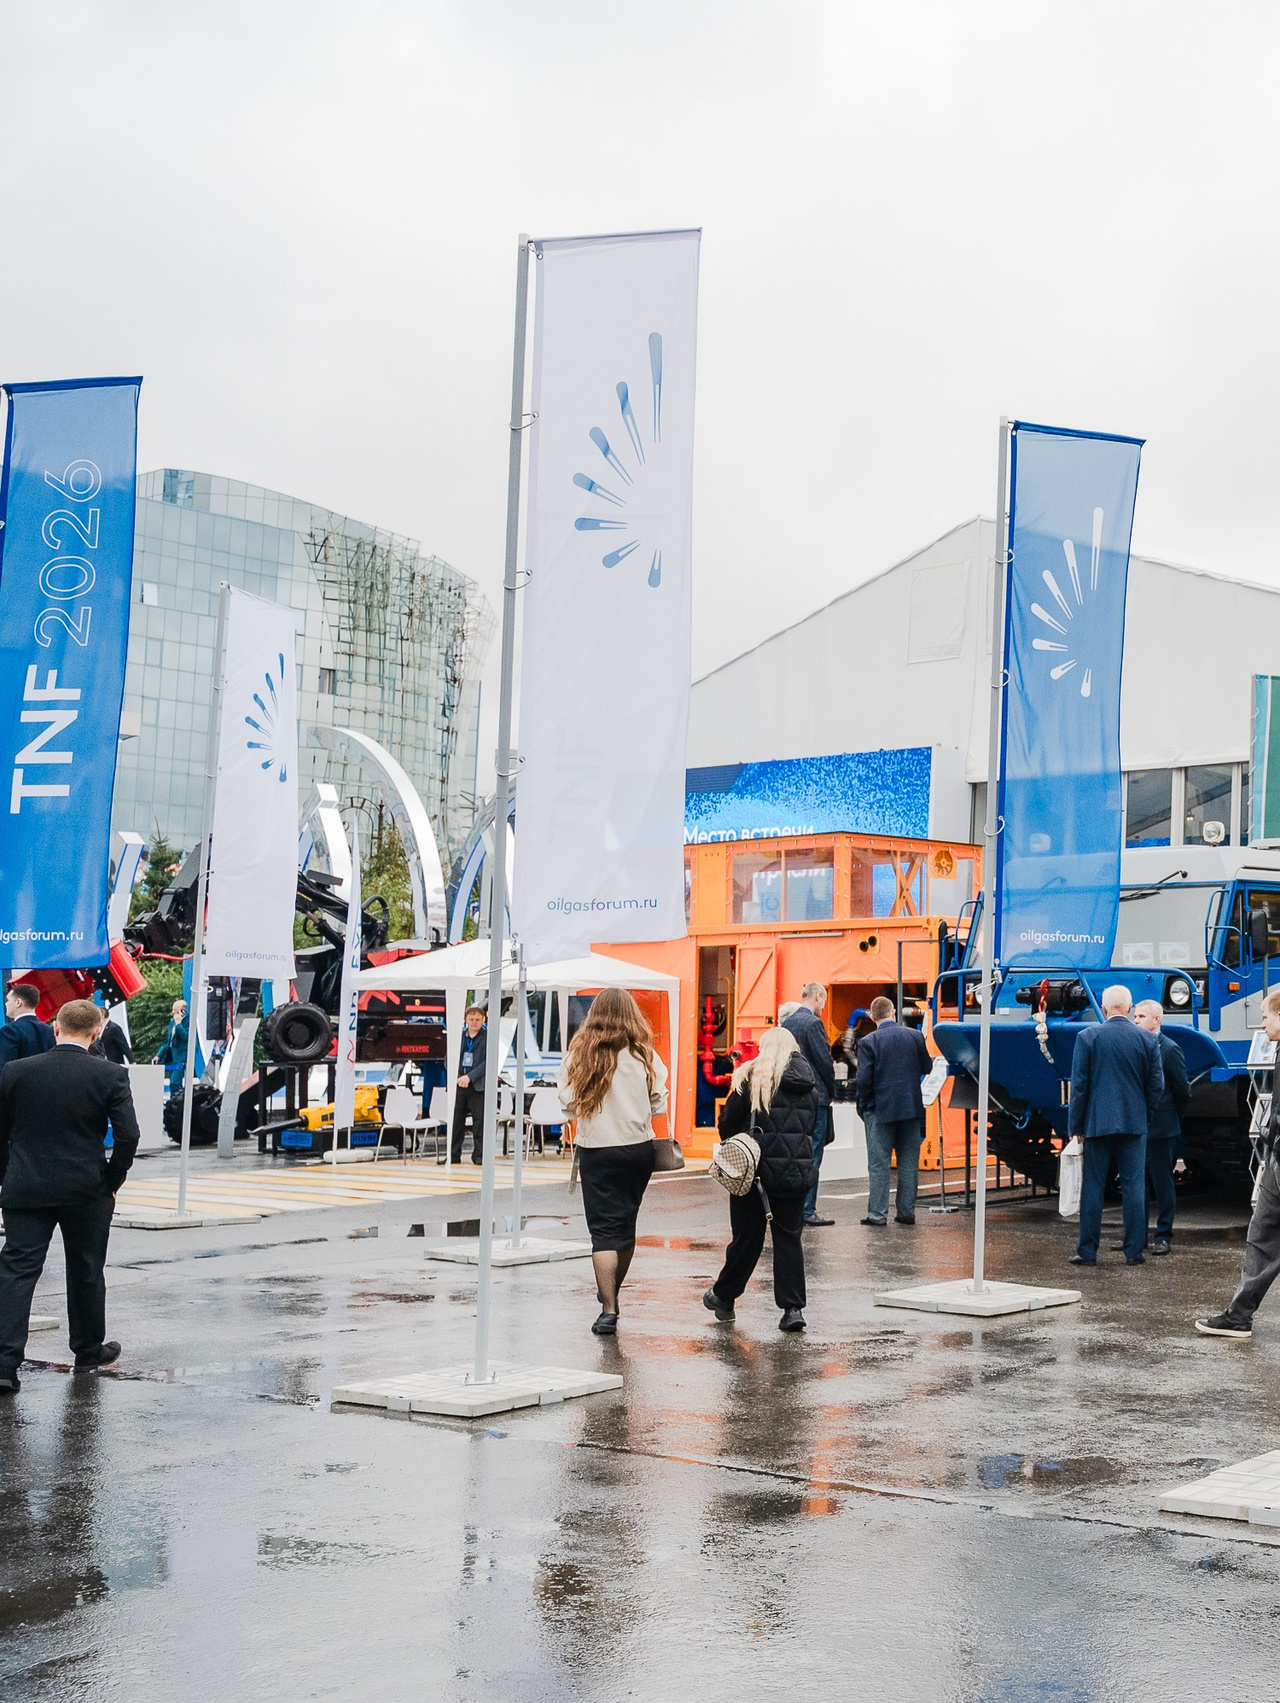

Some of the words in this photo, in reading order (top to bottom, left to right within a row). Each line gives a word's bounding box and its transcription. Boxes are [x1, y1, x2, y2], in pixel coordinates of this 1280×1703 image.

[34, 459, 102, 648] 2026
[10, 664, 82, 814] TNF
[684, 826, 737, 845] Место
[547, 898, 658, 915] oilgasforum.ru
[0, 928, 84, 945] lgasforum.ru
[1019, 929, 1105, 945] oilgasforum.ru
